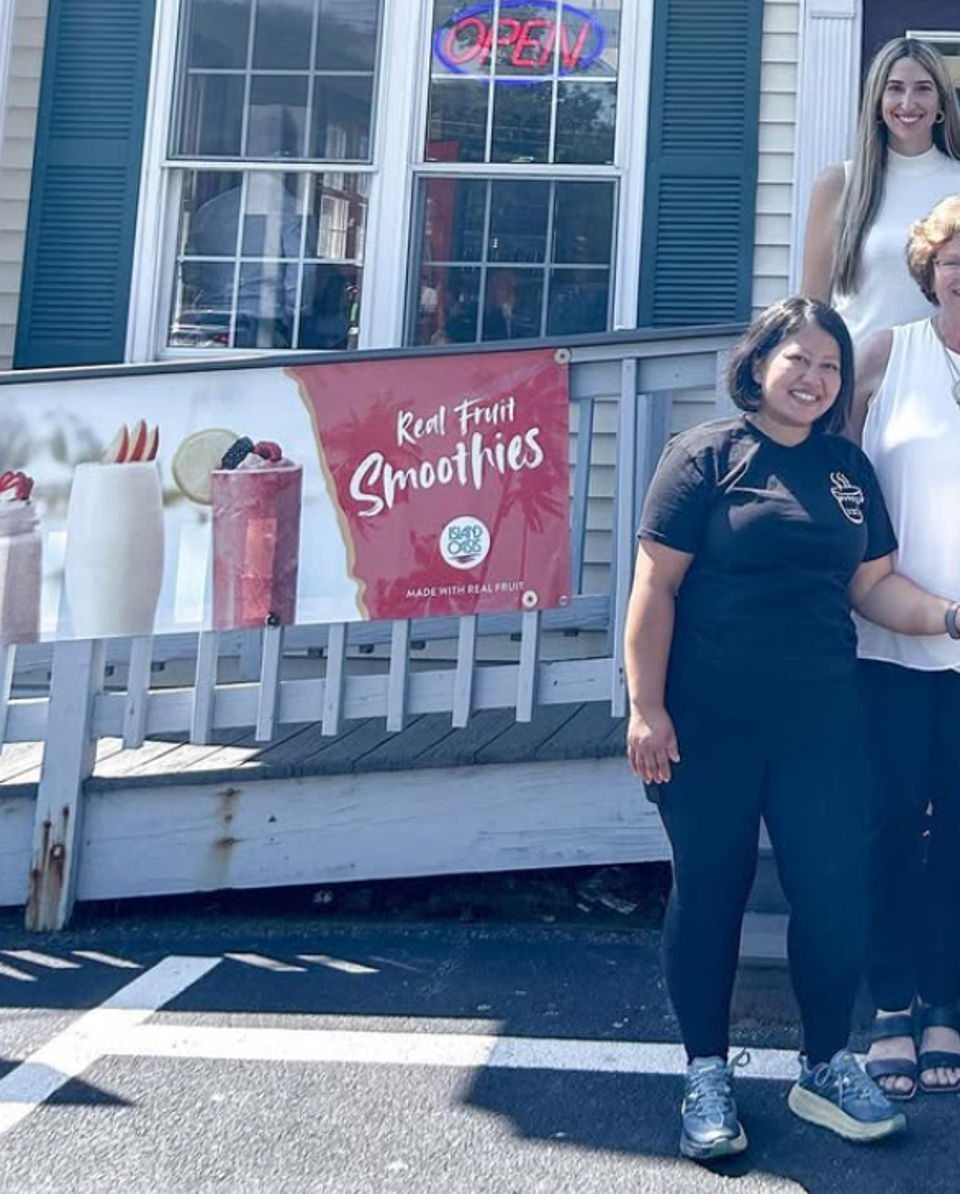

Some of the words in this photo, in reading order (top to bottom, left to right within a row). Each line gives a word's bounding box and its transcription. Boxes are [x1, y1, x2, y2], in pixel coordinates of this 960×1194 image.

[444, 16, 590, 68] OPEN
[397, 405, 446, 447] Real
[454, 396, 515, 436] Fruit
[350, 427, 543, 517] Smoothies
[447, 538, 482, 554] OASIS
[448, 525, 483, 540] ISLAND
[406, 587, 437, 598] MADE
[439, 585, 465, 596] WITH
[467, 583, 493, 594] REAL
[495, 581, 525, 592] FRUIT
